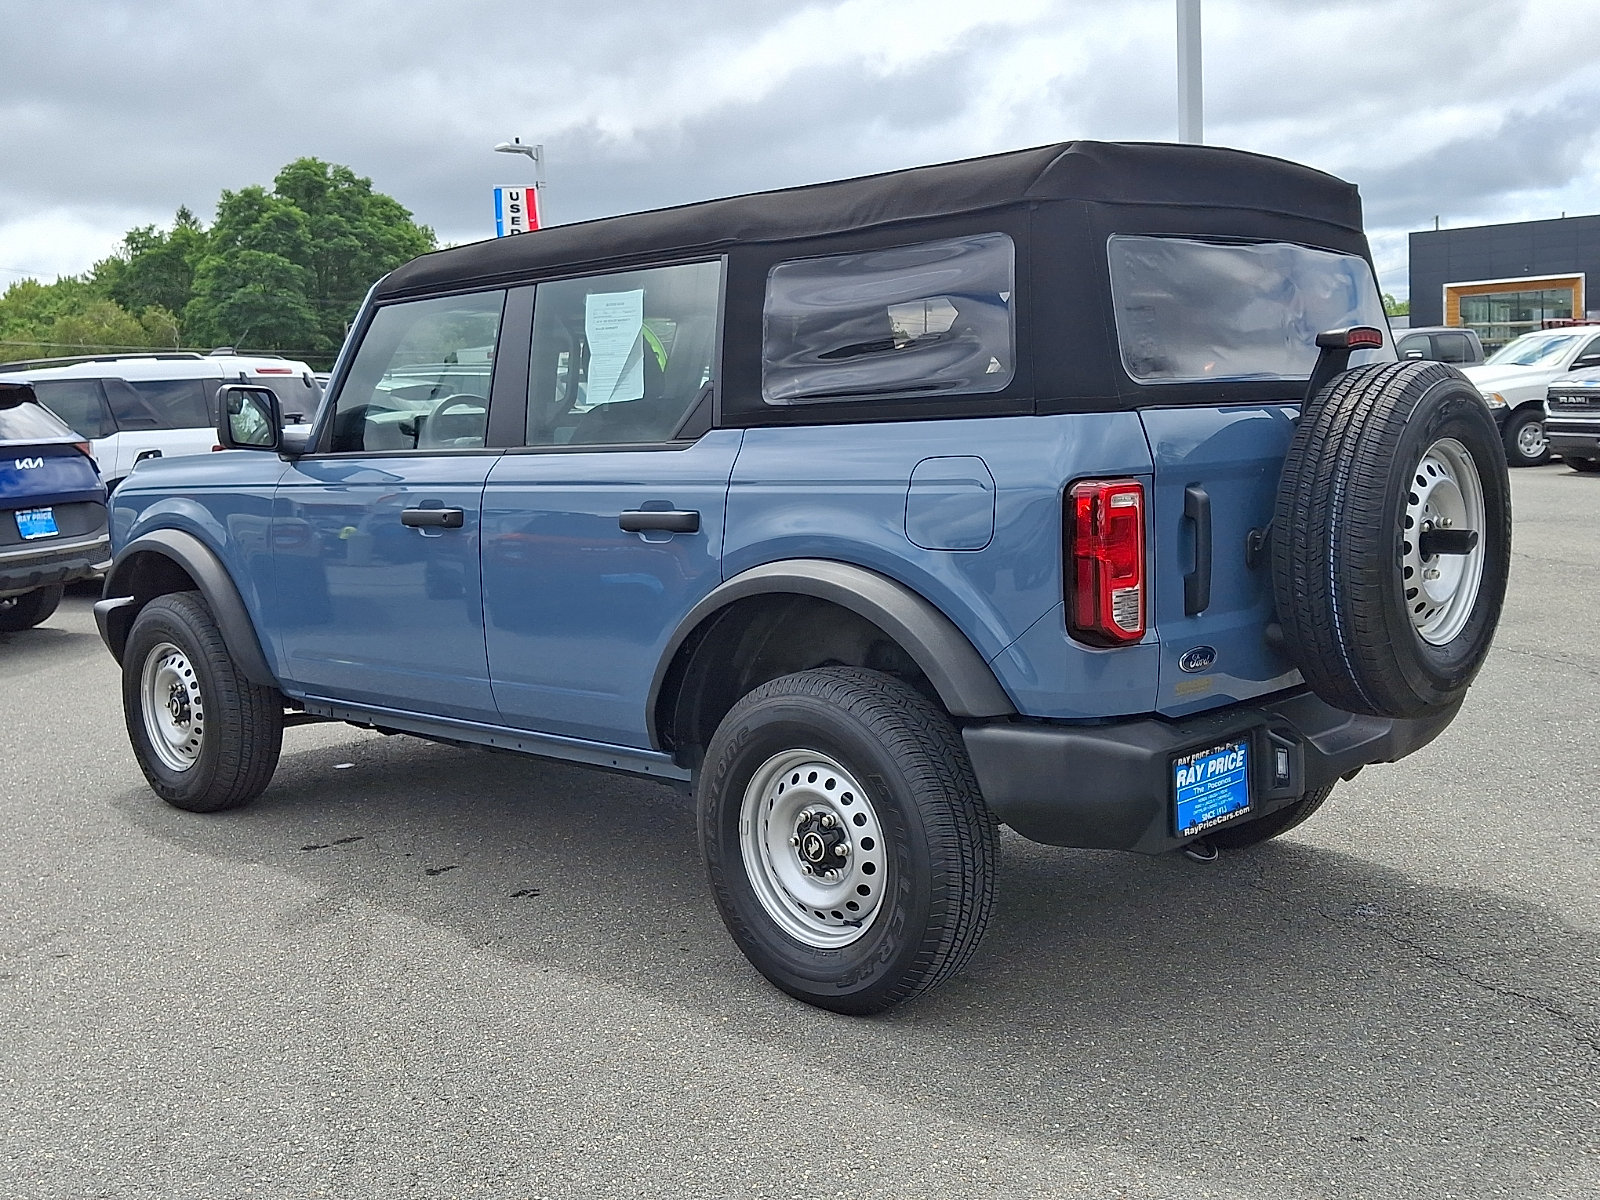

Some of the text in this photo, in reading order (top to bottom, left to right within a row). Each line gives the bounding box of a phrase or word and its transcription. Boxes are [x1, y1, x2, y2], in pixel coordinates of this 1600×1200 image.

[1559, 396, 1590, 404] RAM
[15, 457, 44, 470] KIA
[1176, 749, 1246, 788] RAY PRICE
[1193, 776, 1232, 795] The Poconos
[1184, 805, 1250, 836] RayPriceCars.com
